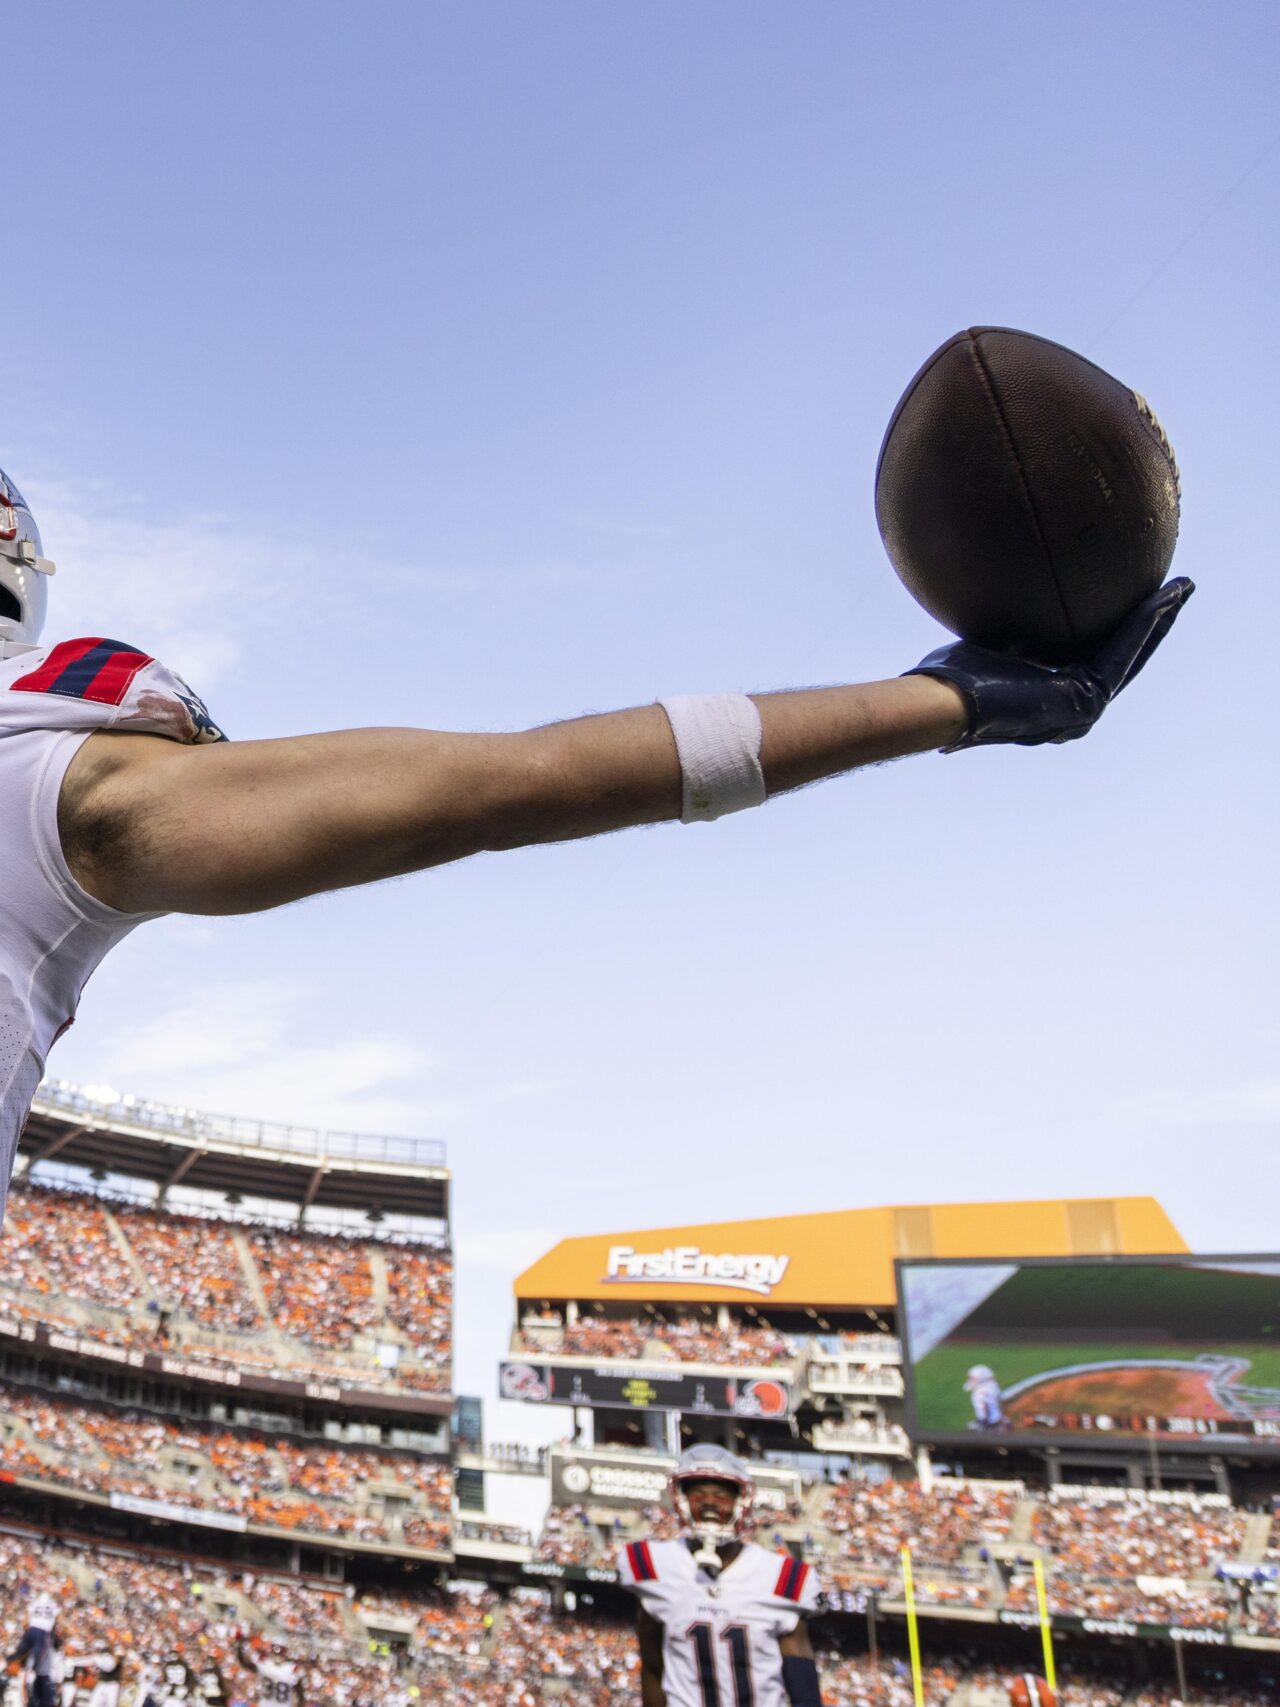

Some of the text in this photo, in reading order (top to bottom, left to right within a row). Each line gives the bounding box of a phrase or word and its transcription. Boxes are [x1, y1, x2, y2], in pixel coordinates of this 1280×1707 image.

[605, 1245, 790, 1294] FirstEnergy
[590, 1466, 668, 1490] CROSSCO
[586, 1567, 618, 1583] evo
[684, 1620, 758, 1707] 11
